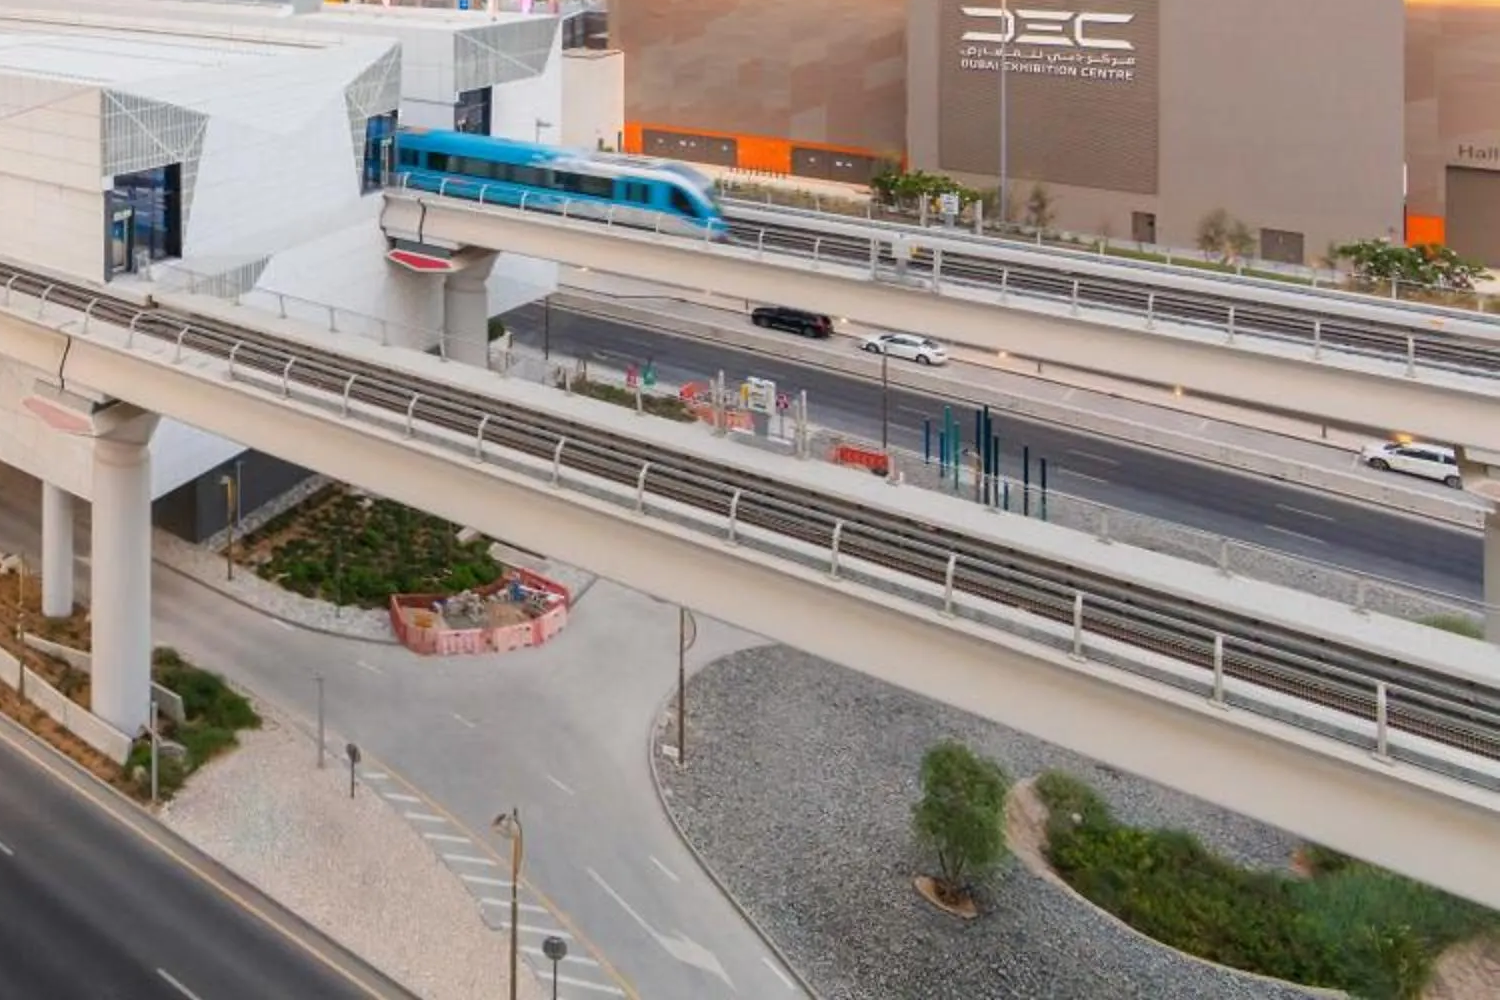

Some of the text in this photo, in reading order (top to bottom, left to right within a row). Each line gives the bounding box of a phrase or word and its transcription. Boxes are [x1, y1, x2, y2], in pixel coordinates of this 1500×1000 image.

[960, 6, 1135, 50] DEC
[961, 58, 1134, 81] DUBAI EXHIBITION CENTRE
[1458, 143, 1499, 162] Hall
